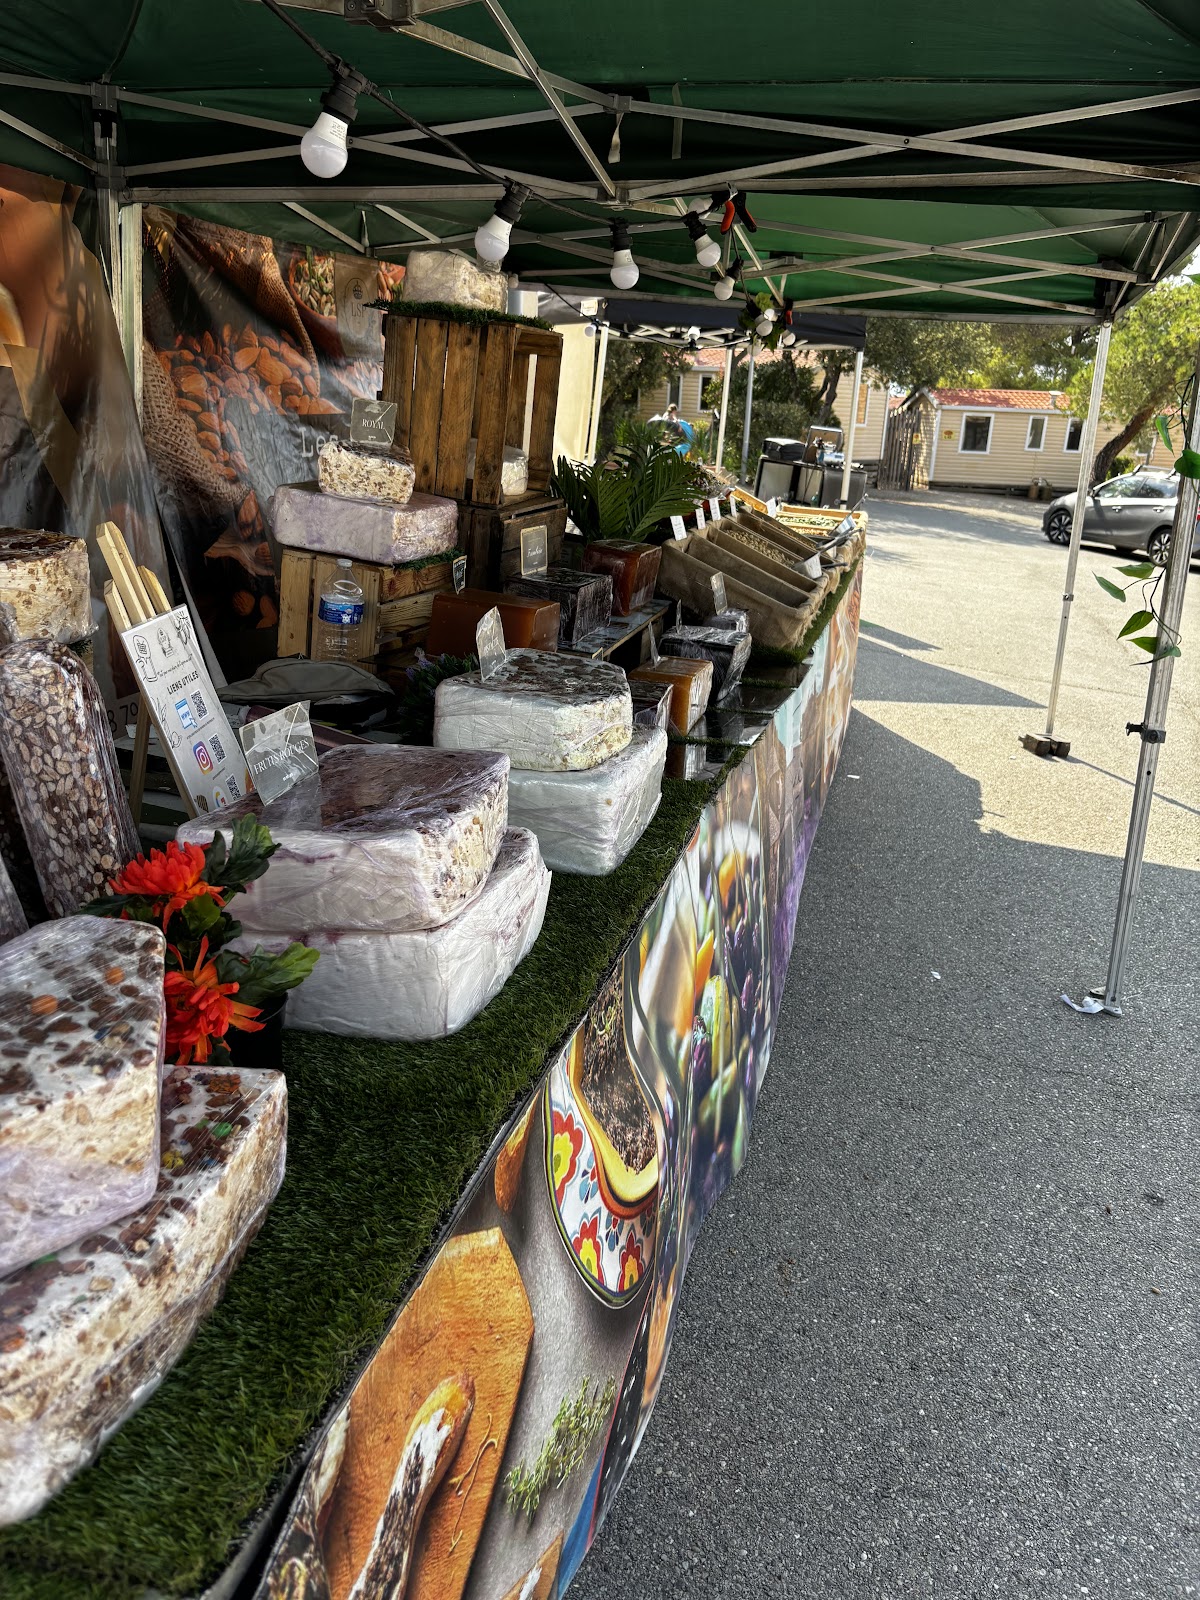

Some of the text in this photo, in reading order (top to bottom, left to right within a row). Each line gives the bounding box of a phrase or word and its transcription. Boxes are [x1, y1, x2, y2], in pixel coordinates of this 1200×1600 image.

[362, 418, 385, 430] ROYAL
[166, 670, 199, 695] LIENS UTILES
